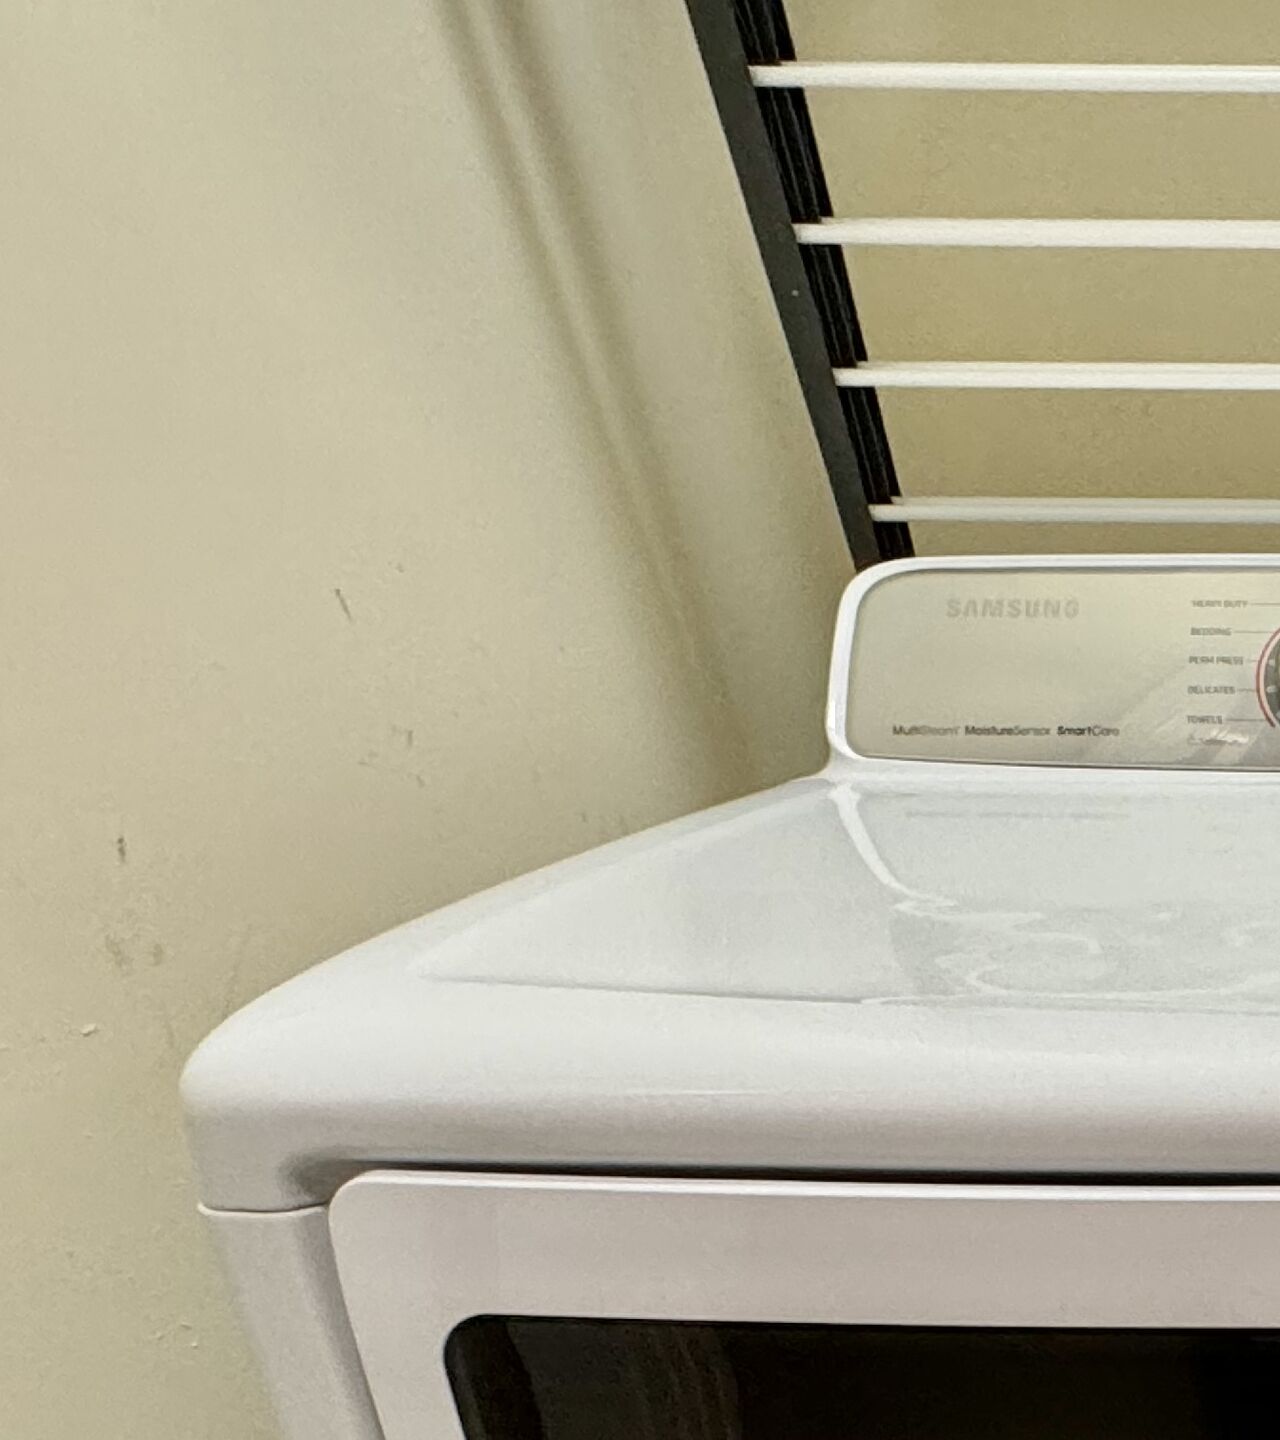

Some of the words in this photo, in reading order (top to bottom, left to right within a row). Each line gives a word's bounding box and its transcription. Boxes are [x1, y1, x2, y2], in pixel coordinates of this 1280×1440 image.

[946, 598, 1080, 618] SAMSUNG
[1224, 599, 1248, 608] DUTY
[1190, 627, 1232, 636] BEDDING
[1189, 656, 1215, 664] PERM
[1217, 656, 1243, 665] PRESS
[1188, 685, 1235, 694] DELICATES
[1187, 715, 1223, 724] TOWELS
[964, 725, 1050, 736] MoistureSensor
[1056, 725, 1120, 737] SmartCare
